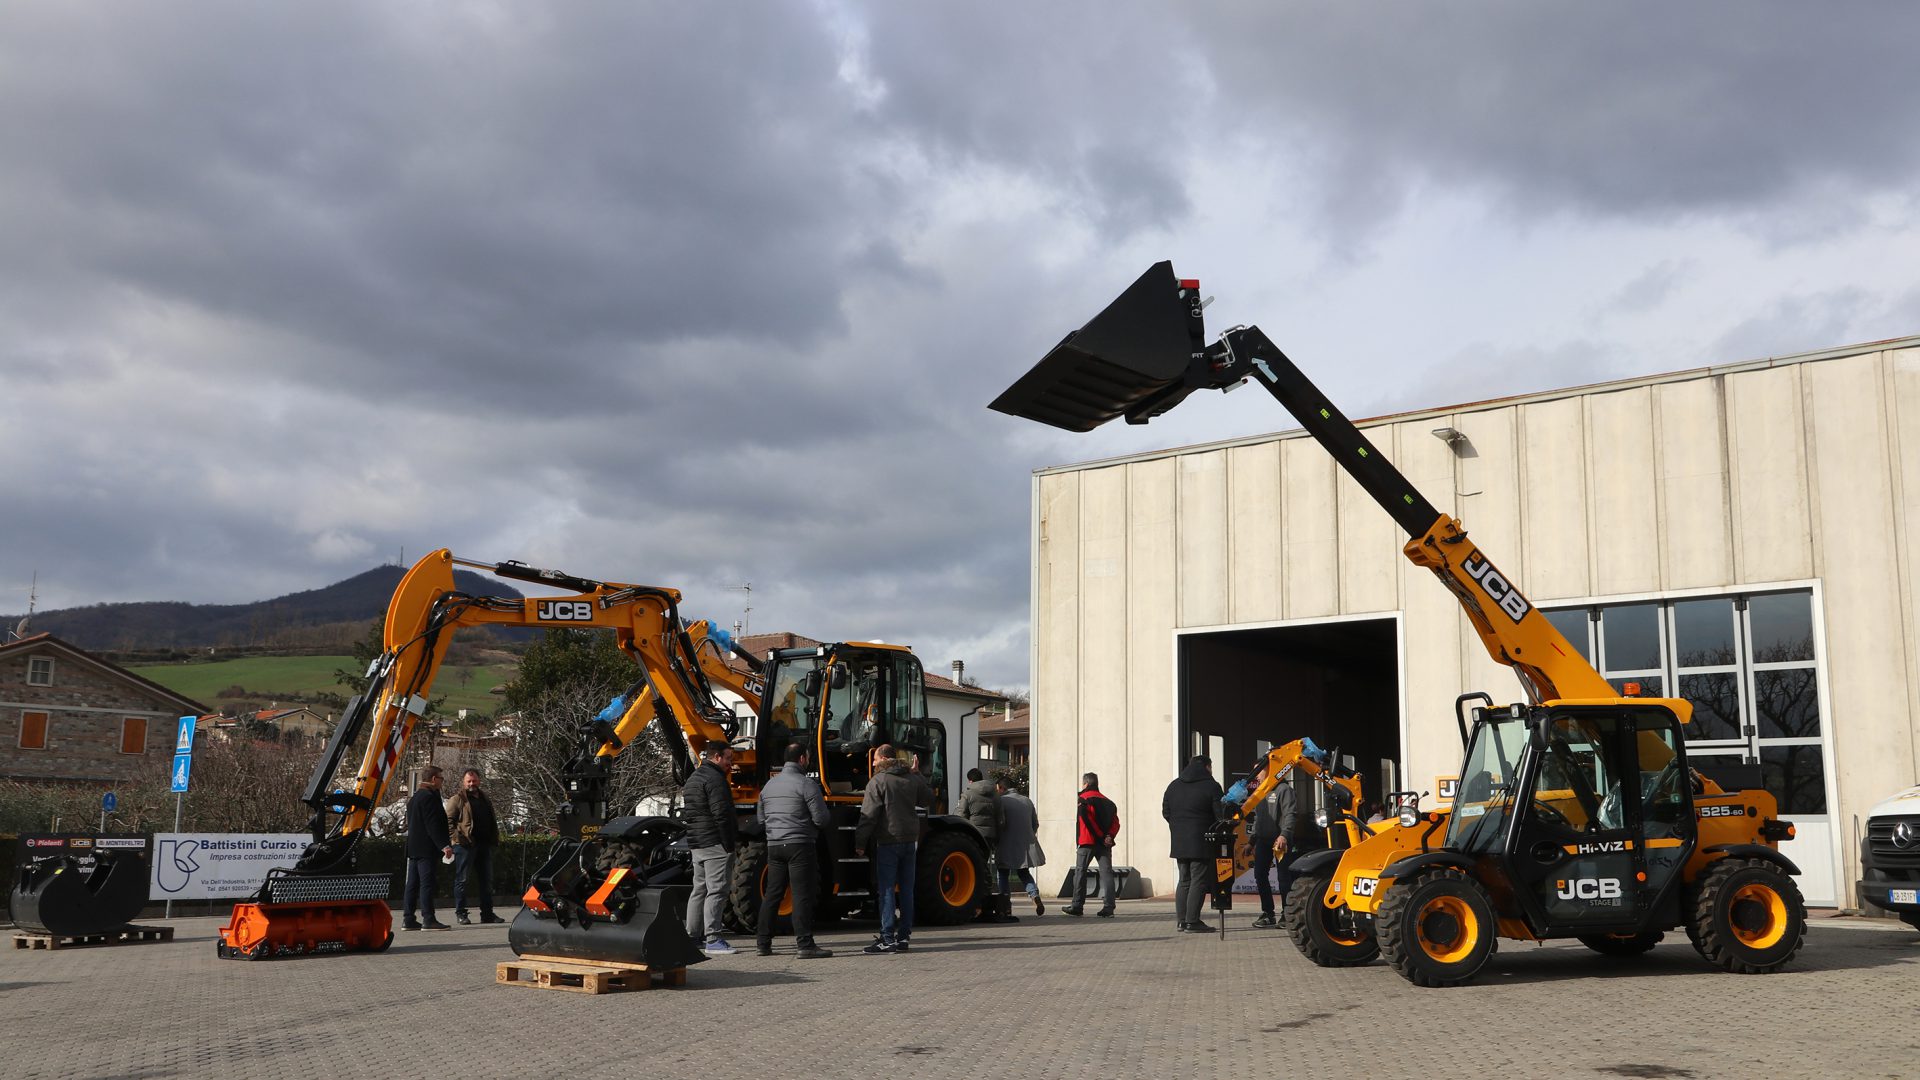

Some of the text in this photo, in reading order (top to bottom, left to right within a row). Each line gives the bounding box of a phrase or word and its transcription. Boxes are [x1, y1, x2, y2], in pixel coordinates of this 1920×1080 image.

[1464, 559, 1528, 621] JCB
[538, 602, 592, 620] JCB
[743, 680, 763, 697] JC
[1701, 806, 1744, 817] 525-60
[200, 840, 257, 850] Battistini
[260, 840, 297, 850] Curzio
[209, 853, 242, 862] Impresa
[243, 852, 286, 861] costruzioni
[1557, 878, 1622, 900] JCB
